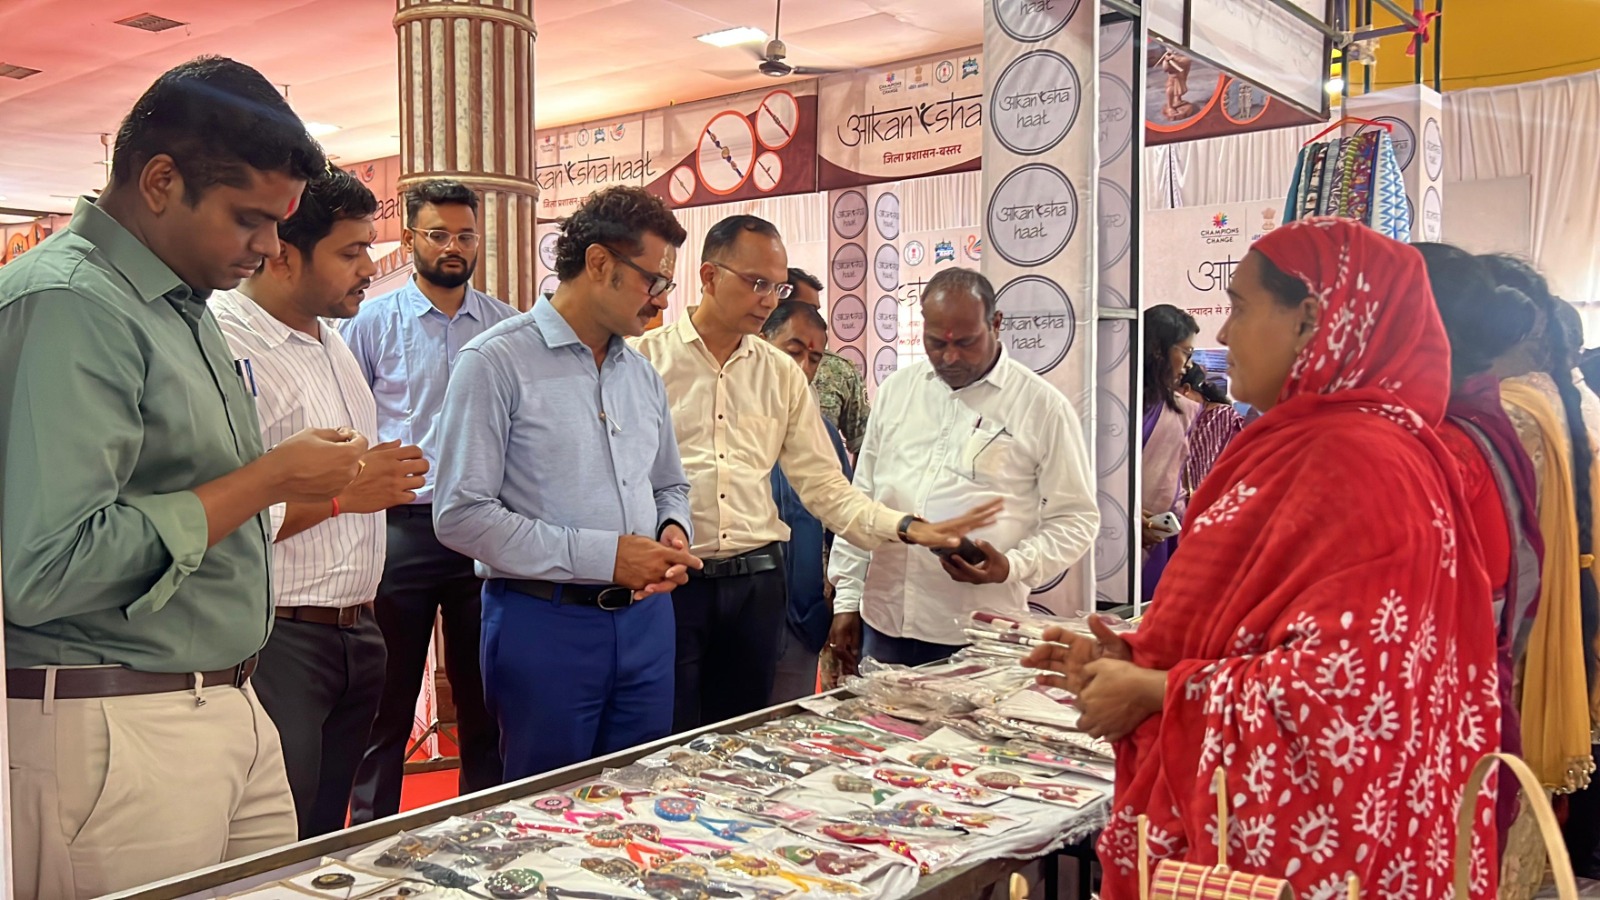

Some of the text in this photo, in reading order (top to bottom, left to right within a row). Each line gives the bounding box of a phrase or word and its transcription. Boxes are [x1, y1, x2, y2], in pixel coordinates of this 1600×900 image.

[1016, 110, 1051, 128] haat
[883, 152, 904, 164] जिला
[611, 151, 657, 182] haat
[374, 191, 400, 220] aat
[1013, 222, 1048, 240] haat
[1201, 227, 1239, 236] CHAMPIONS
[1215, 304, 1222, 314] से
[1011, 335, 1046, 350] haat
